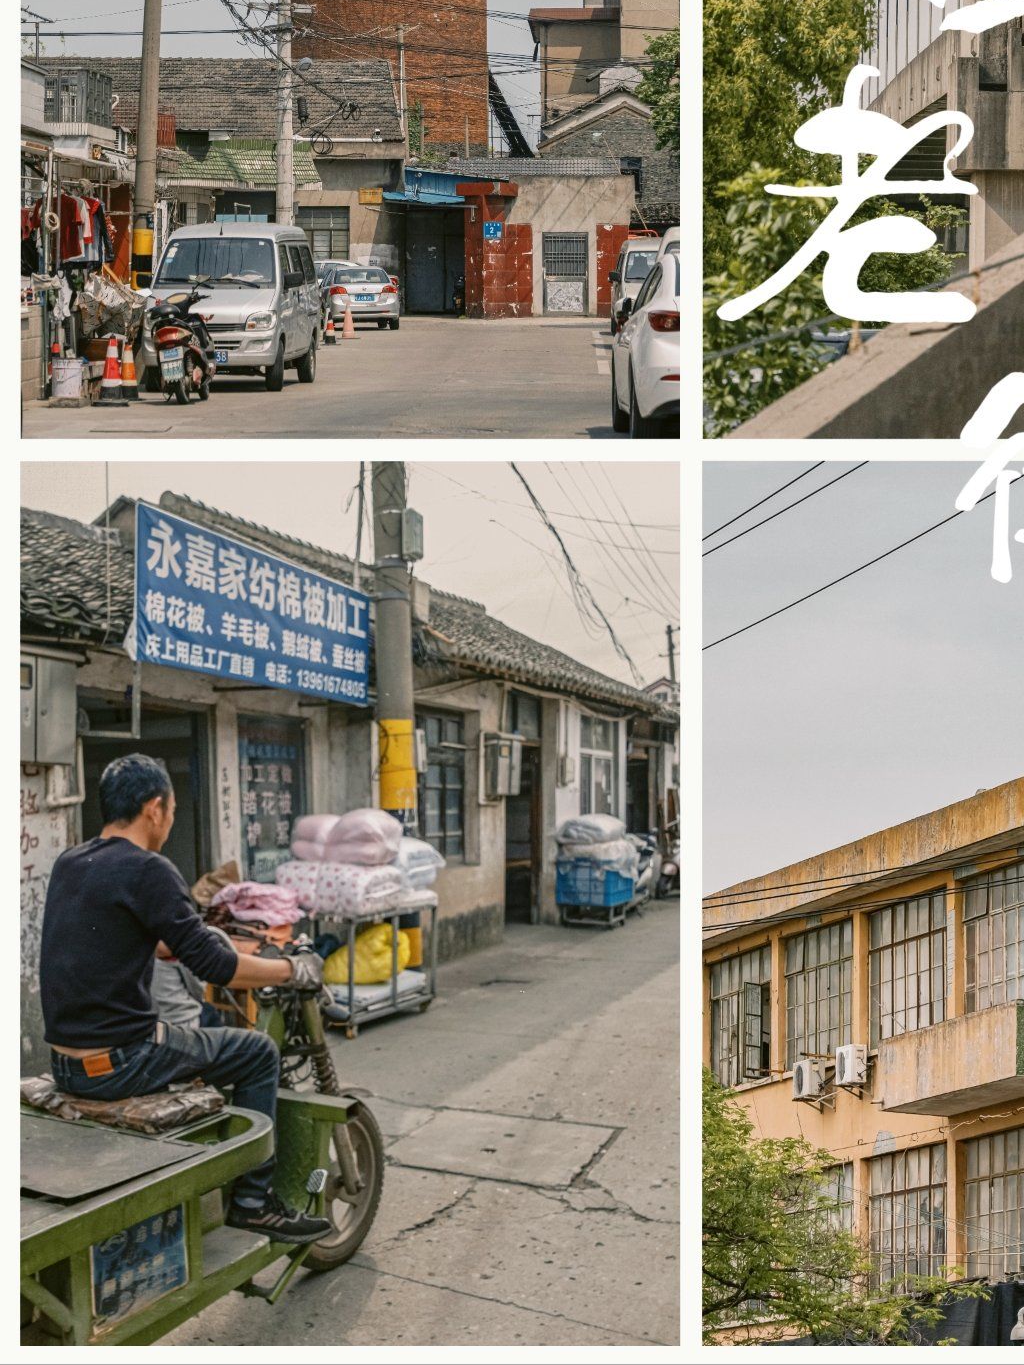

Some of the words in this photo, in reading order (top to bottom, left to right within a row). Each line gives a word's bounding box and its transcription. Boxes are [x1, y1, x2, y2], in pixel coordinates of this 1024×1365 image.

[488, 226, 495, 234] 2
[146, 519, 367, 639] 永嘉家纺棉被加工
[145, 634, 255, 678] 床上用品工厂直销
